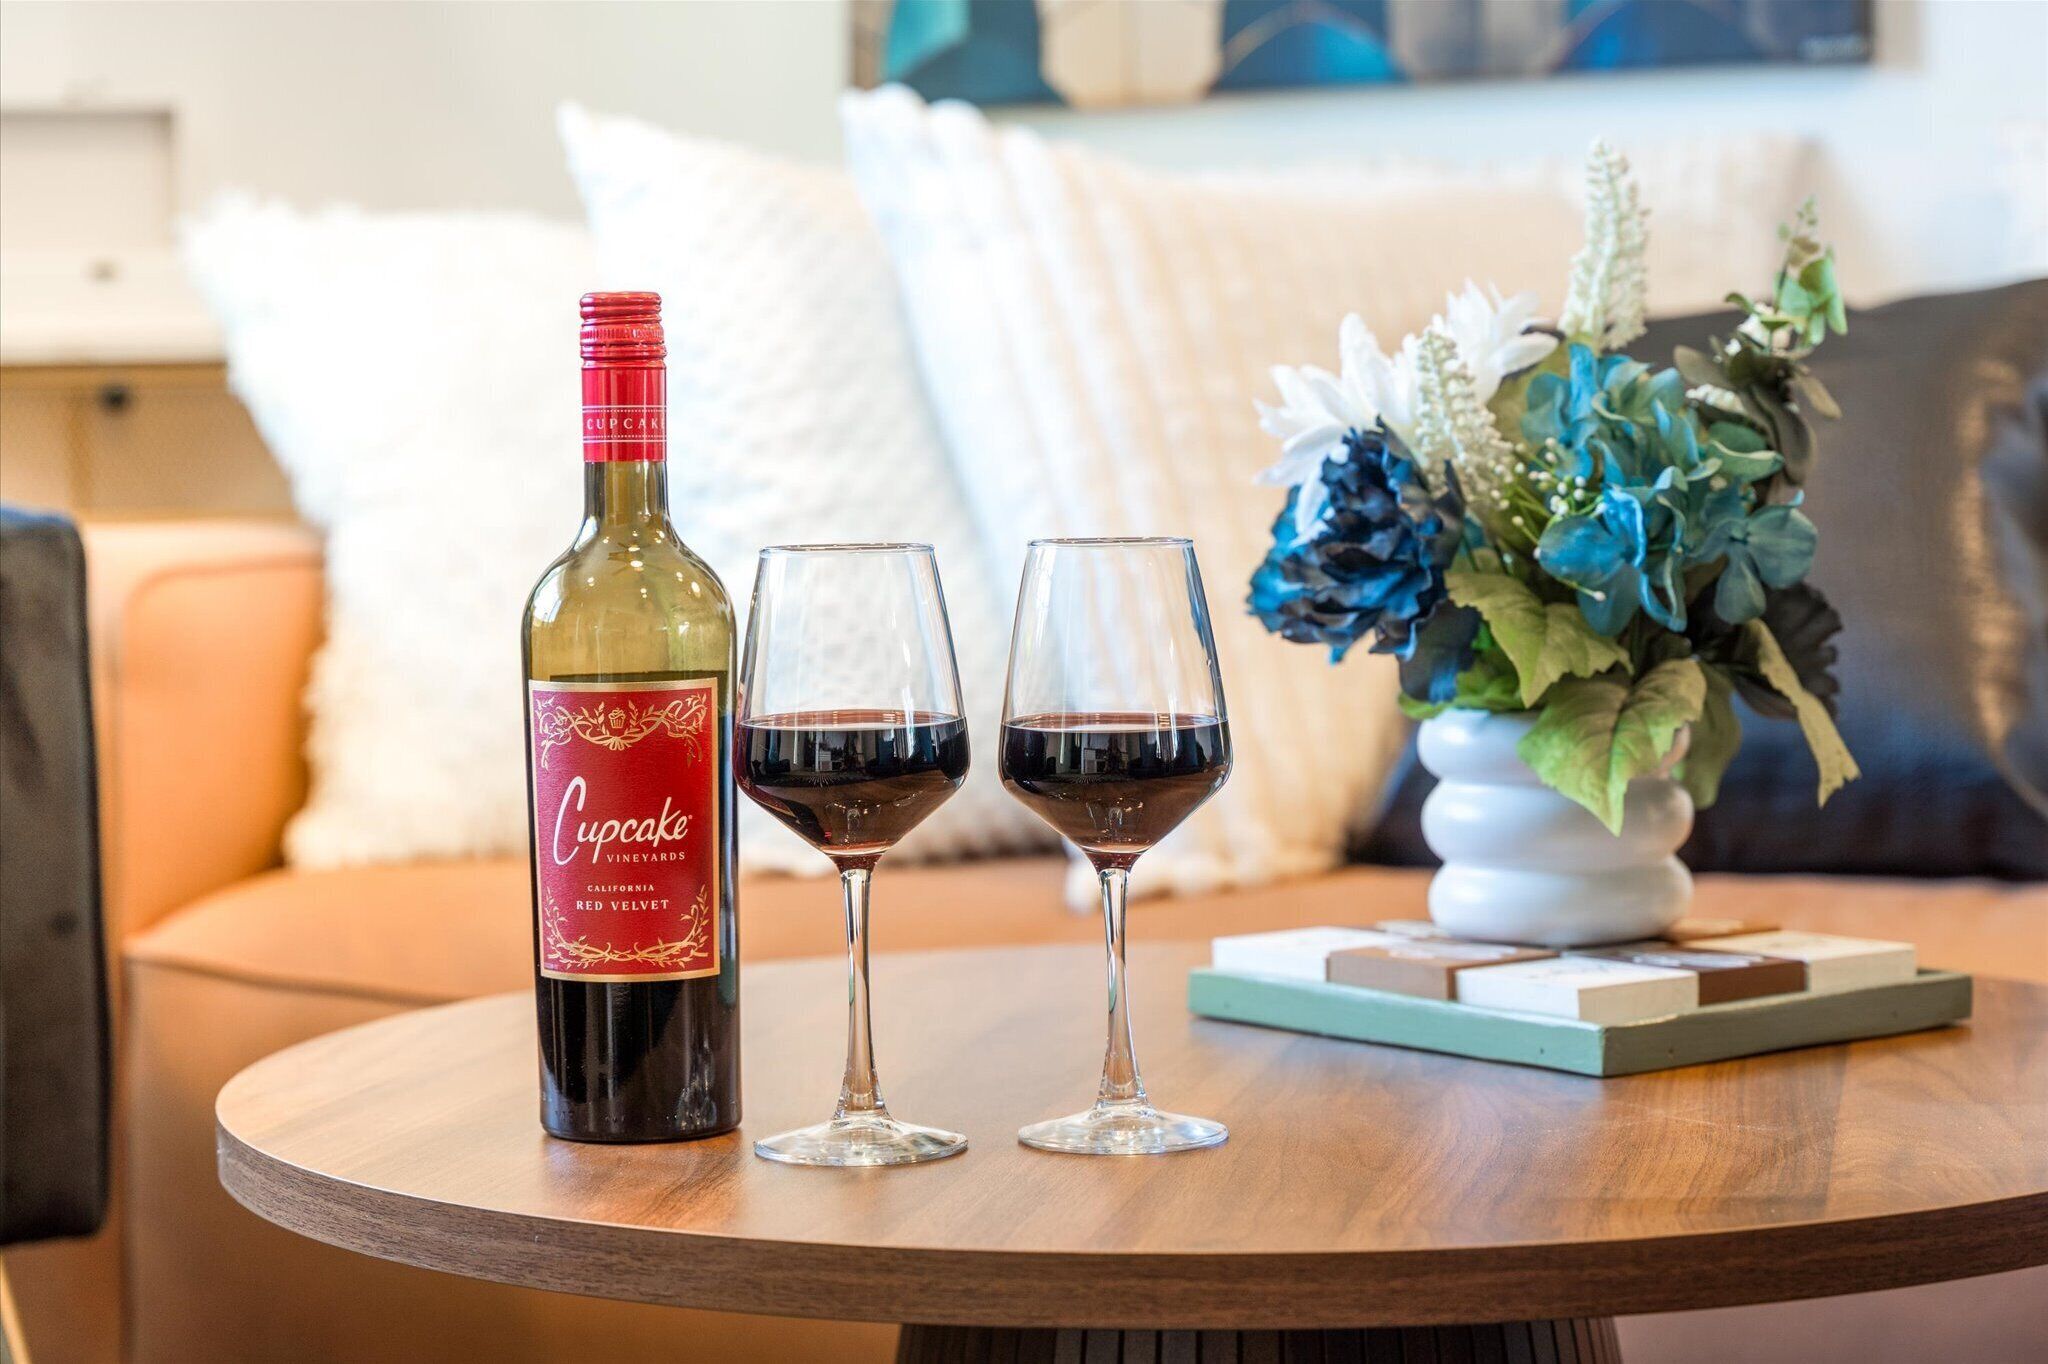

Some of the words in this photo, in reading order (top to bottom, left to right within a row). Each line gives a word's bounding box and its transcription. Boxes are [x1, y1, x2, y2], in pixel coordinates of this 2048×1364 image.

[553, 776, 688, 865] Cupcake
[606, 851, 686, 863] VINEYARDS
[587, 884, 655, 892] CALIFORNIA
[576, 900, 603, 911] RED
[611, 900, 670, 911] VELVET
